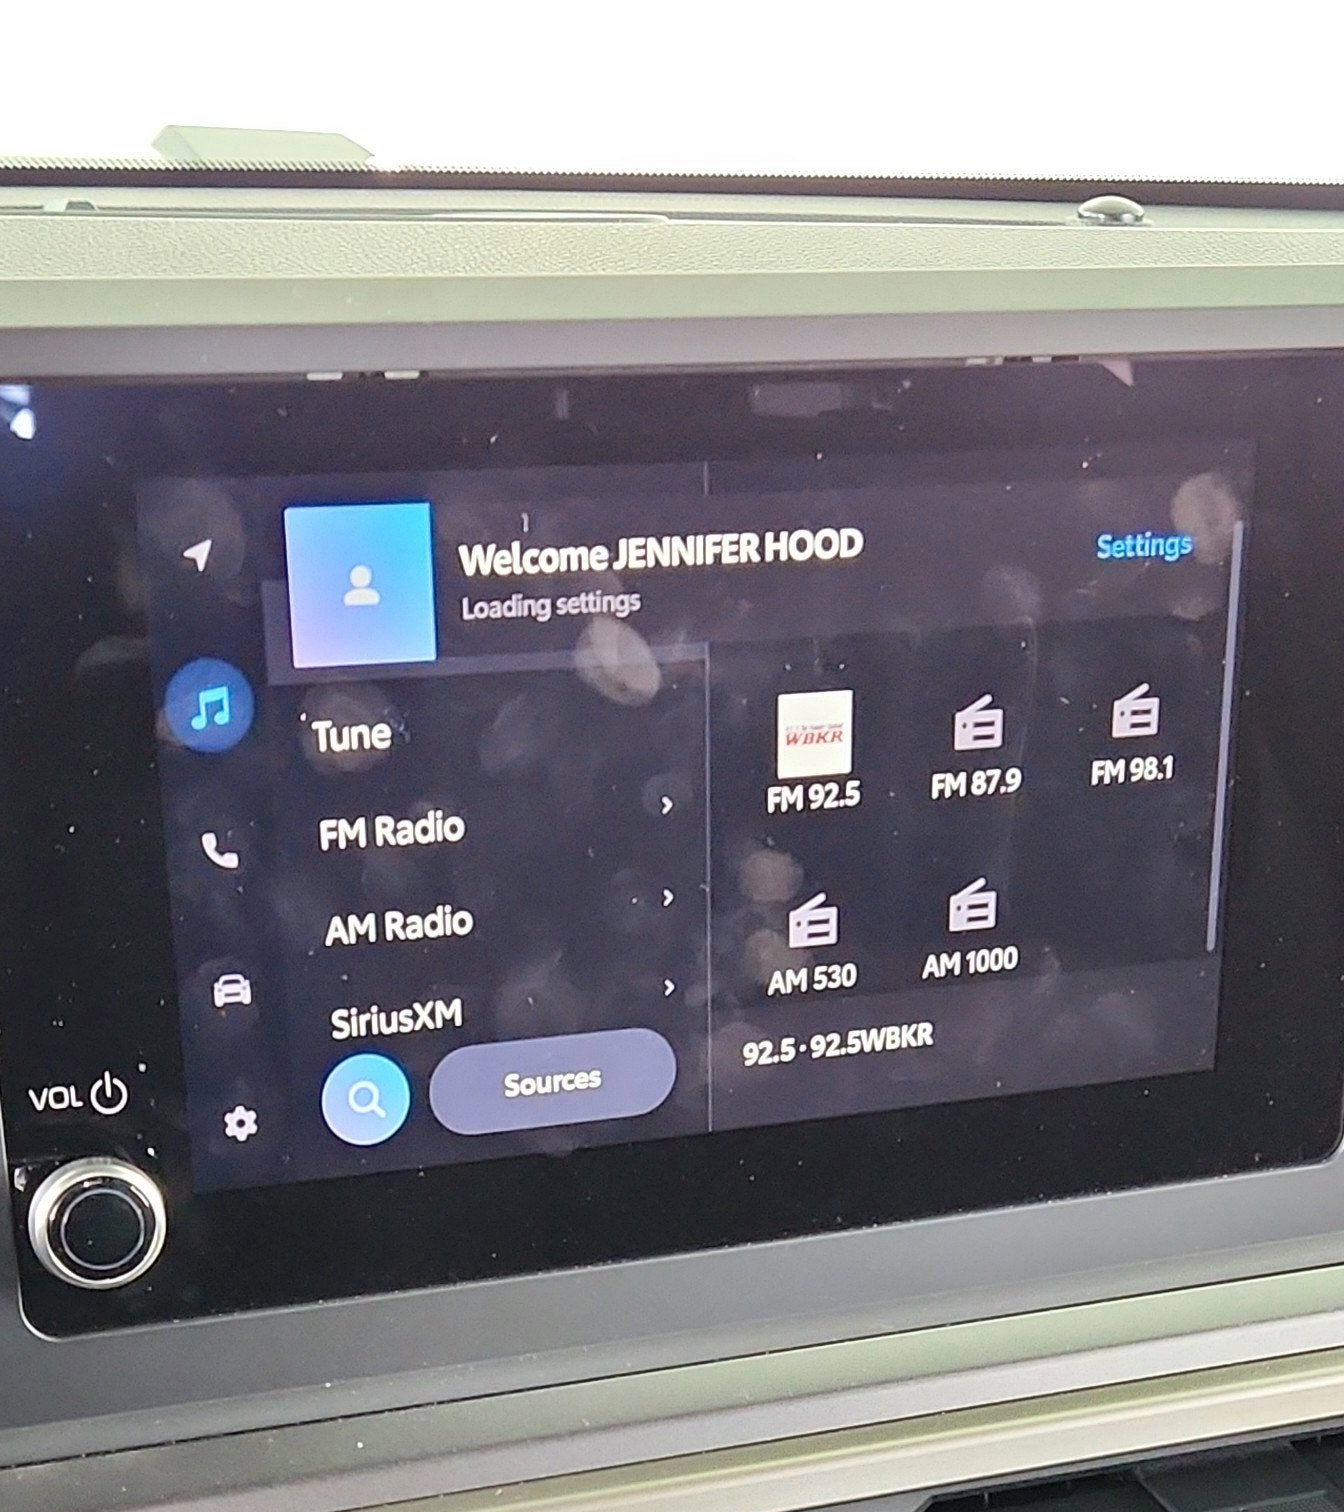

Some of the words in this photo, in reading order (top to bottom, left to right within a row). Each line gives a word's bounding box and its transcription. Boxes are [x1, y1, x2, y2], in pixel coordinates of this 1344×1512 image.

[458, 541, 610, 577] Welcome
[612, 532, 762, 571] JENNIFER
[765, 527, 864, 563] HOOD
[1096, 532, 1194, 562] Settings
[462, 592, 553, 622] Loading
[556, 590, 642, 618] settings
[311, 719, 393, 754] Tune
[931, 773, 968, 800] FM
[970, 768, 1023, 797] 87.9
[1090, 760, 1127, 787] FM
[1129, 755, 1176, 783] 98.1
[766, 786, 807, 814] FM
[810, 780, 861, 811] 92.5
[319, 818, 367, 851] FM
[373, 810, 467, 848] Radio
[324, 914, 378, 947] AM
[383, 905, 475, 942] Radio
[767, 968, 807, 996] AM
[813, 963, 858, 991] 530
[922, 952, 961, 980] AM
[965, 946, 1019, 974] 1000
[330, 998, 463, 1040] SiriusXM
[742, 1037, 796, 1067] 92.5
[503, 1066, 602, 1098] Sources
[28, 1086, 84, 1112] VOL
